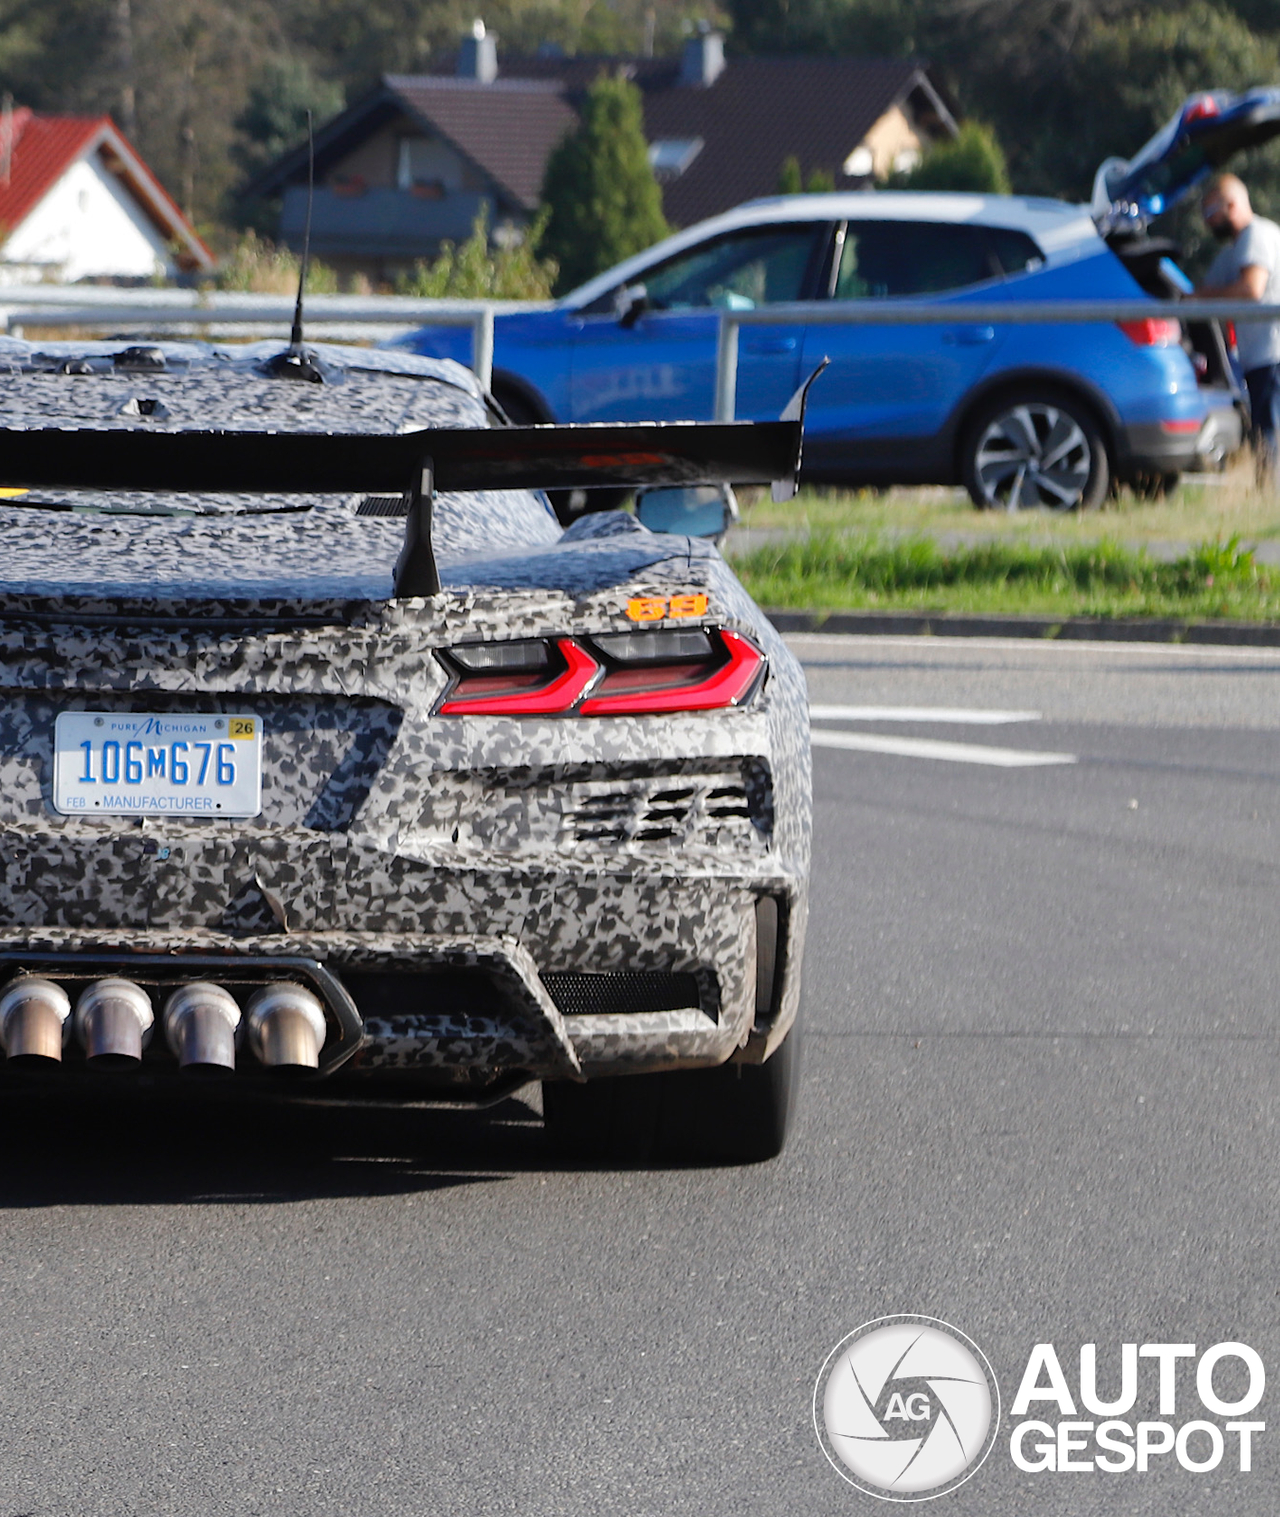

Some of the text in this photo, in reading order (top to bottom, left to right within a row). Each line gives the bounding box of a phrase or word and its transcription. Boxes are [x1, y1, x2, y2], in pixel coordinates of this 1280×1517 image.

[111, 723, 138, 732] PURE
[234, 722, 254, 734] 26
[78, 740, 236, 786] 106M676
[66, 797, 86, 808] FEB
[103, 796, 213, 810] MANUFACTURER
